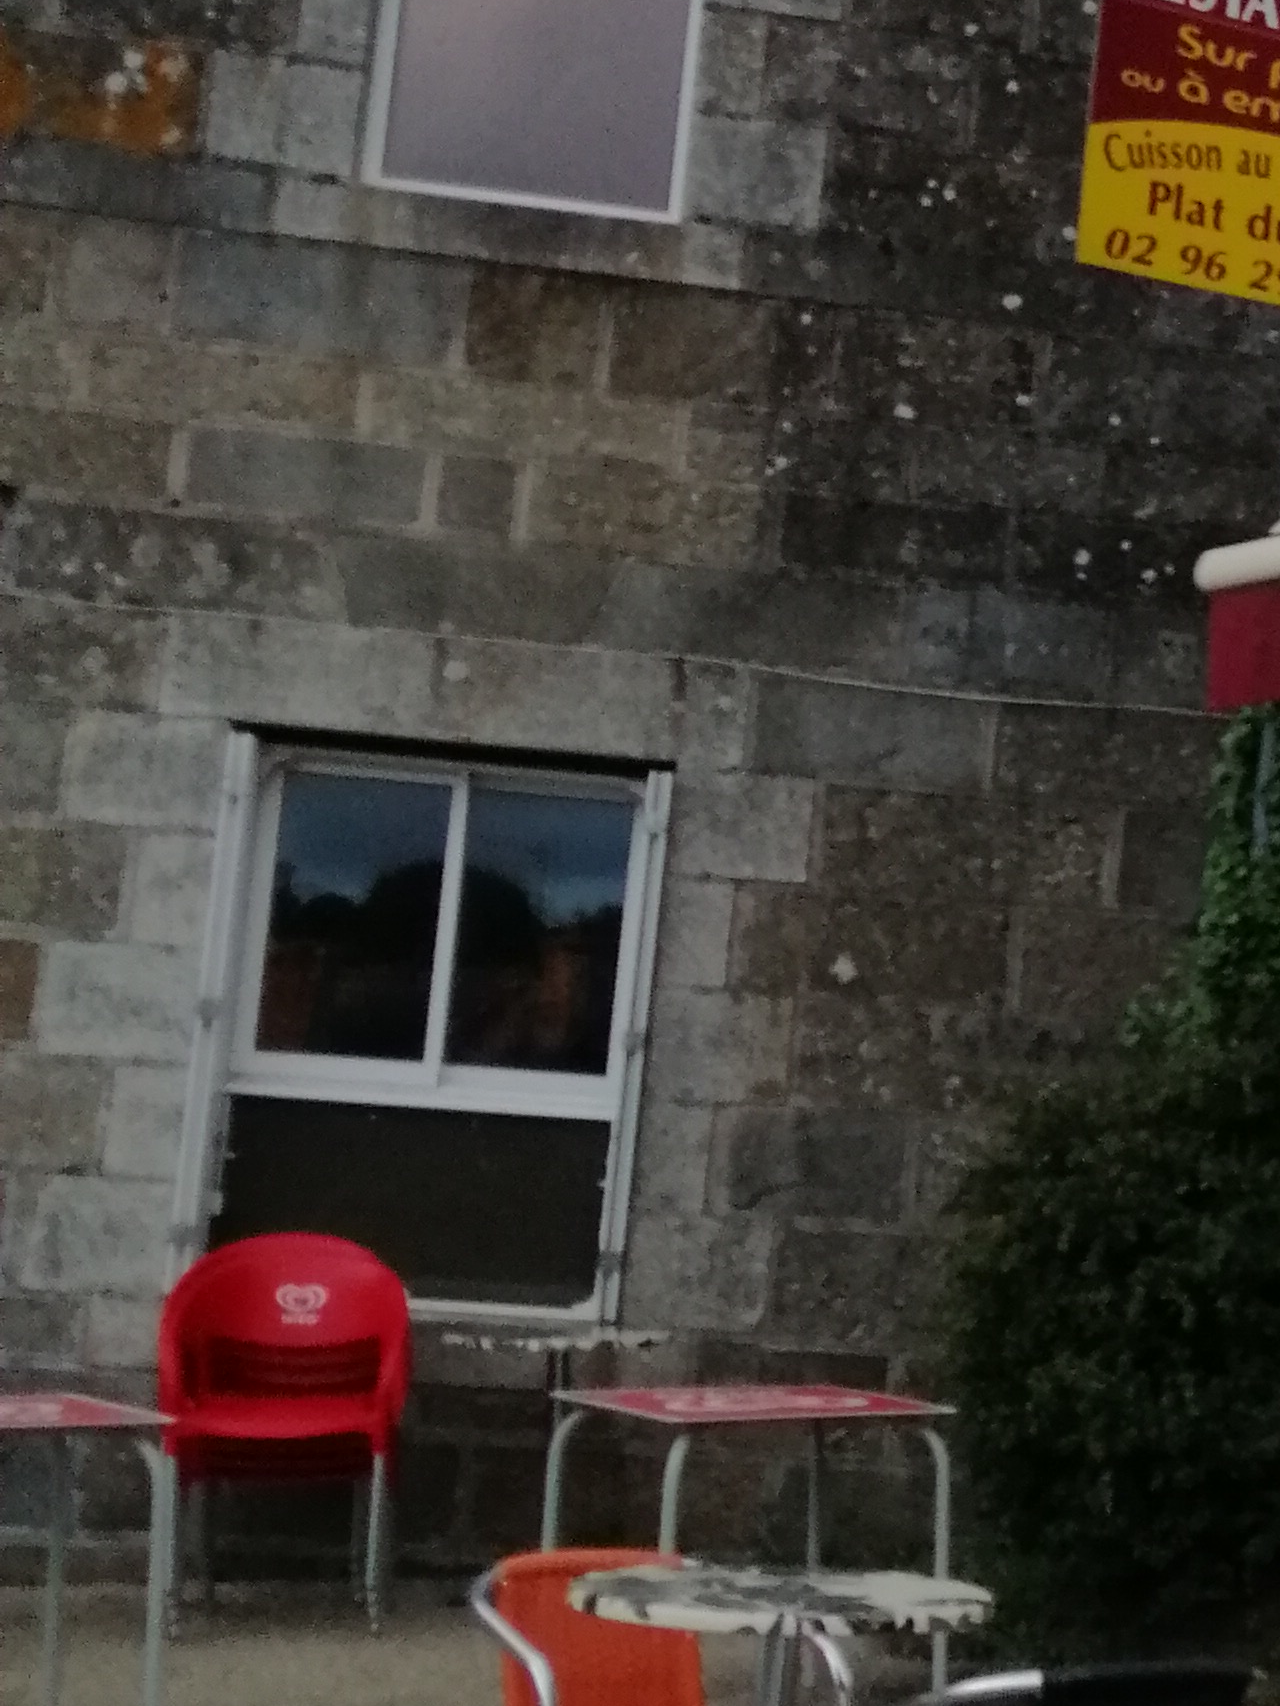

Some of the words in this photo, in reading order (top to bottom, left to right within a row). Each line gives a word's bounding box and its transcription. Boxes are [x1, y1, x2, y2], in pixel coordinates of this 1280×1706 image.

[1176, 23, 1257, 72] Sur
[1120, 68, 1165, 94] ou
[1177, 67, 1210, 105] à
[1103, 130, 1223, 173] Cuisson
[1236, 147, 1271, 179] au
[1147, 180, 1225, 232] Plat
[1105, 228, 1158, 267] 02
[1179, 244, 1228, 282] 96
